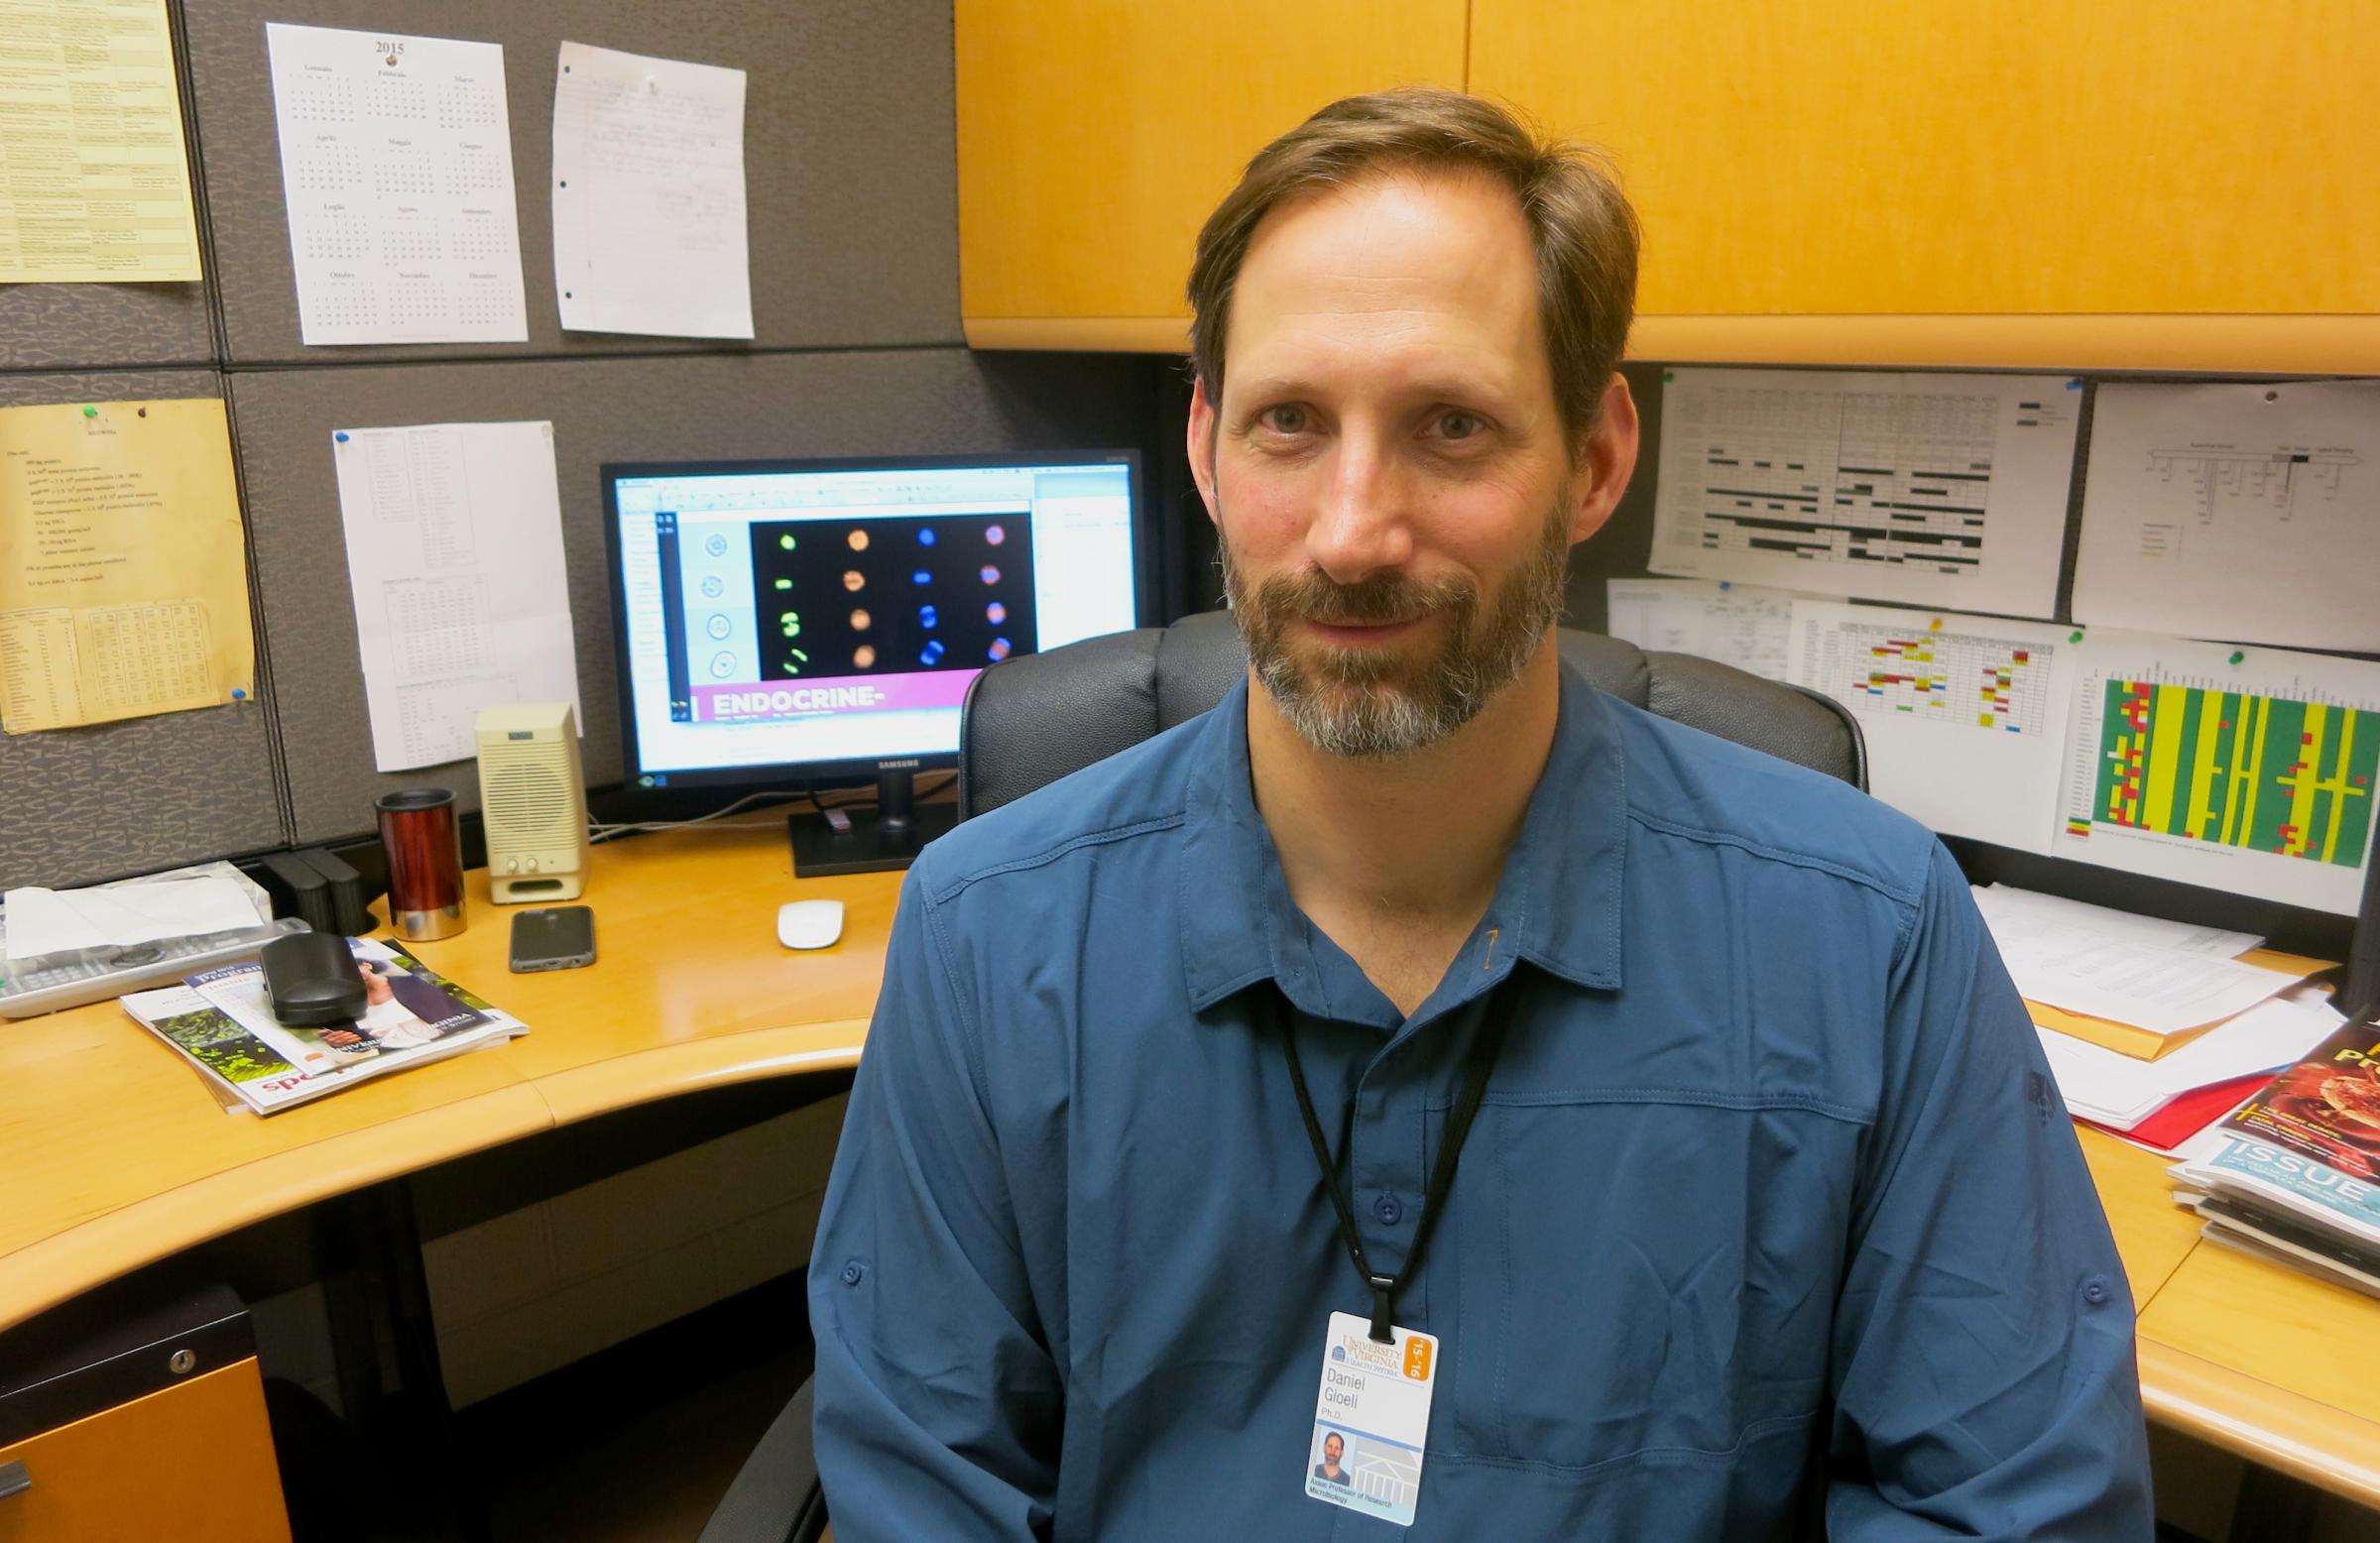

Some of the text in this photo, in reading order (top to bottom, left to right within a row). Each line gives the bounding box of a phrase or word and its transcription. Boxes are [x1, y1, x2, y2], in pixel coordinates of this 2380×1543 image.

[375, 41, 405, 56] 2015
[713, 686, 886, 715] ENDOCRINE-
[879, 759, 919, 770] SAMSUNG
[2232, 1142, 2372, 1200] ISSUE
[1343, 1335, 1401, 1359] UNIVERSITY
[1353, 1348, 1398, 1368] VIRGINIA
[1327, 1367, 1366, 1391] Daniel
[1324, 1386, 1359, 1409] Gioeli
